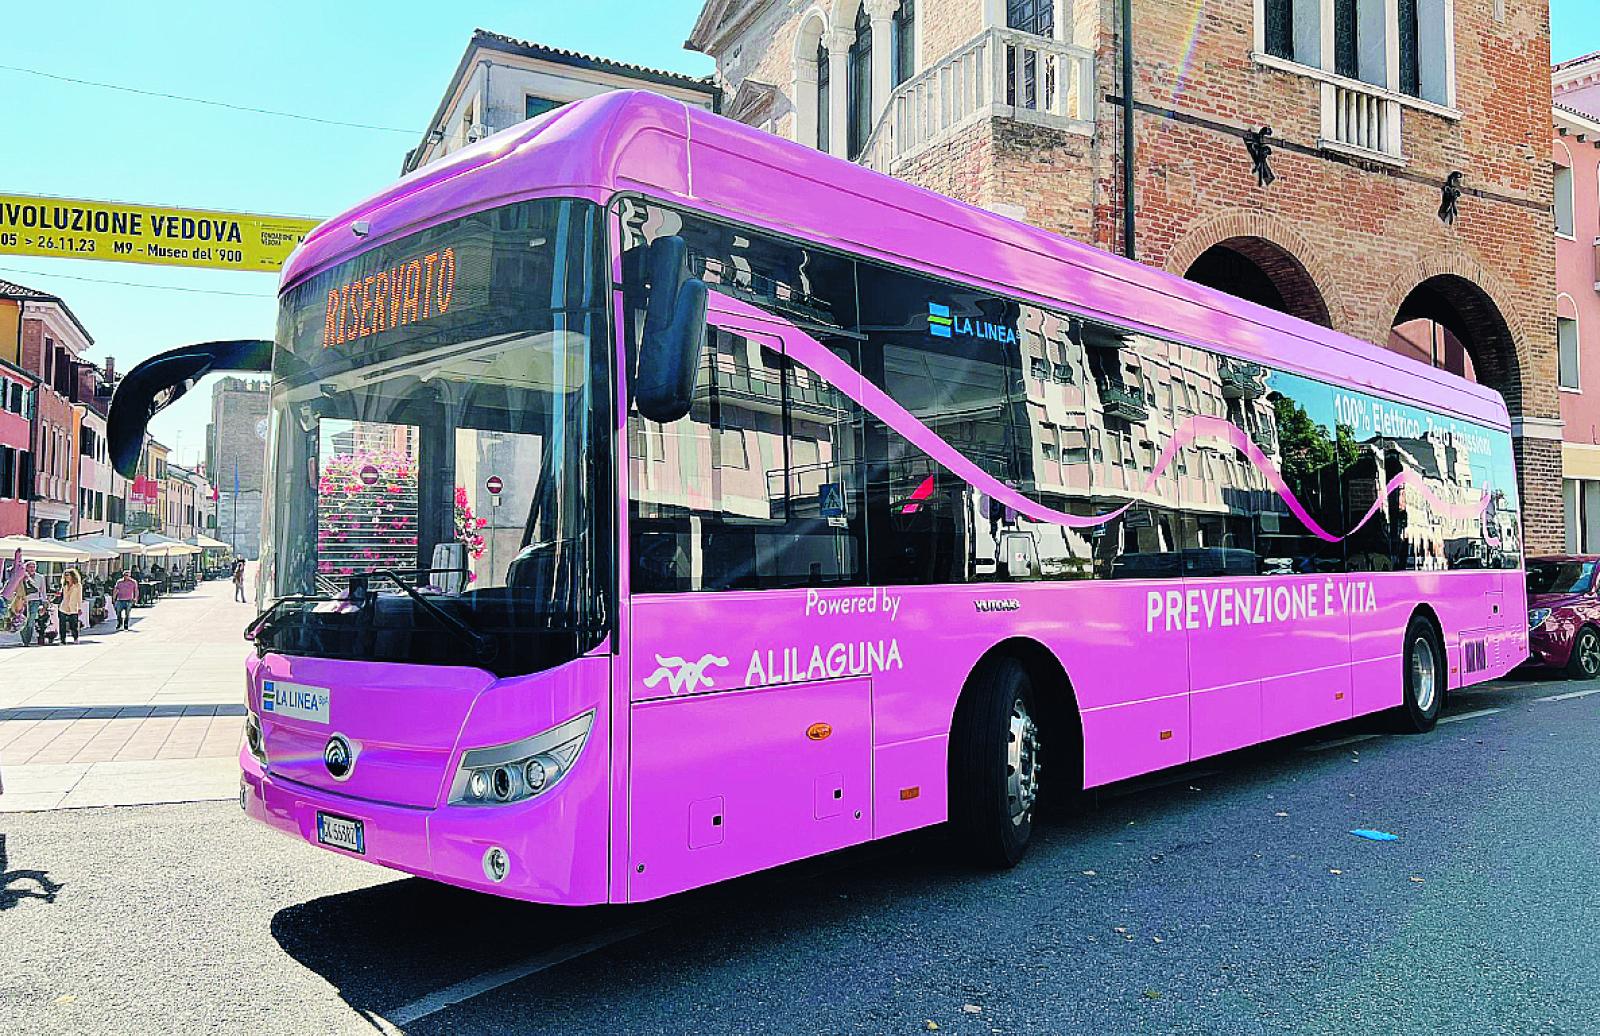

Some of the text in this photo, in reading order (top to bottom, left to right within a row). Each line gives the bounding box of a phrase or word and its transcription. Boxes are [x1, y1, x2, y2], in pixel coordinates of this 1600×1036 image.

[1, 232, 17, 246] 05
[38, 235, 95, 252] 26.11.23
[151, 215, 242, 243] VEDOVA
[114, 241, 133, 254] M9
[147, 243, 188, 259] Museo
[193, 247, 212, 260] del
[216, 248, 242, 262] '900
[323, 247, 456, 348] RISERVATO
[953, 315, 974, 336] LA
[976, 320, 1016, 345] LINEA
[1335, 393, 1492, 456] 100% Elettrico Zero Emissioni
[805, 586, 901, 621] Powered by
[1146, 577, 1377, 632] PREVENZIONE È VITA
[744, 638, 904, 687] ALILAGUNA
[276, 689, 287, 707] LA
[289, 690, 318, 711] LINEA
